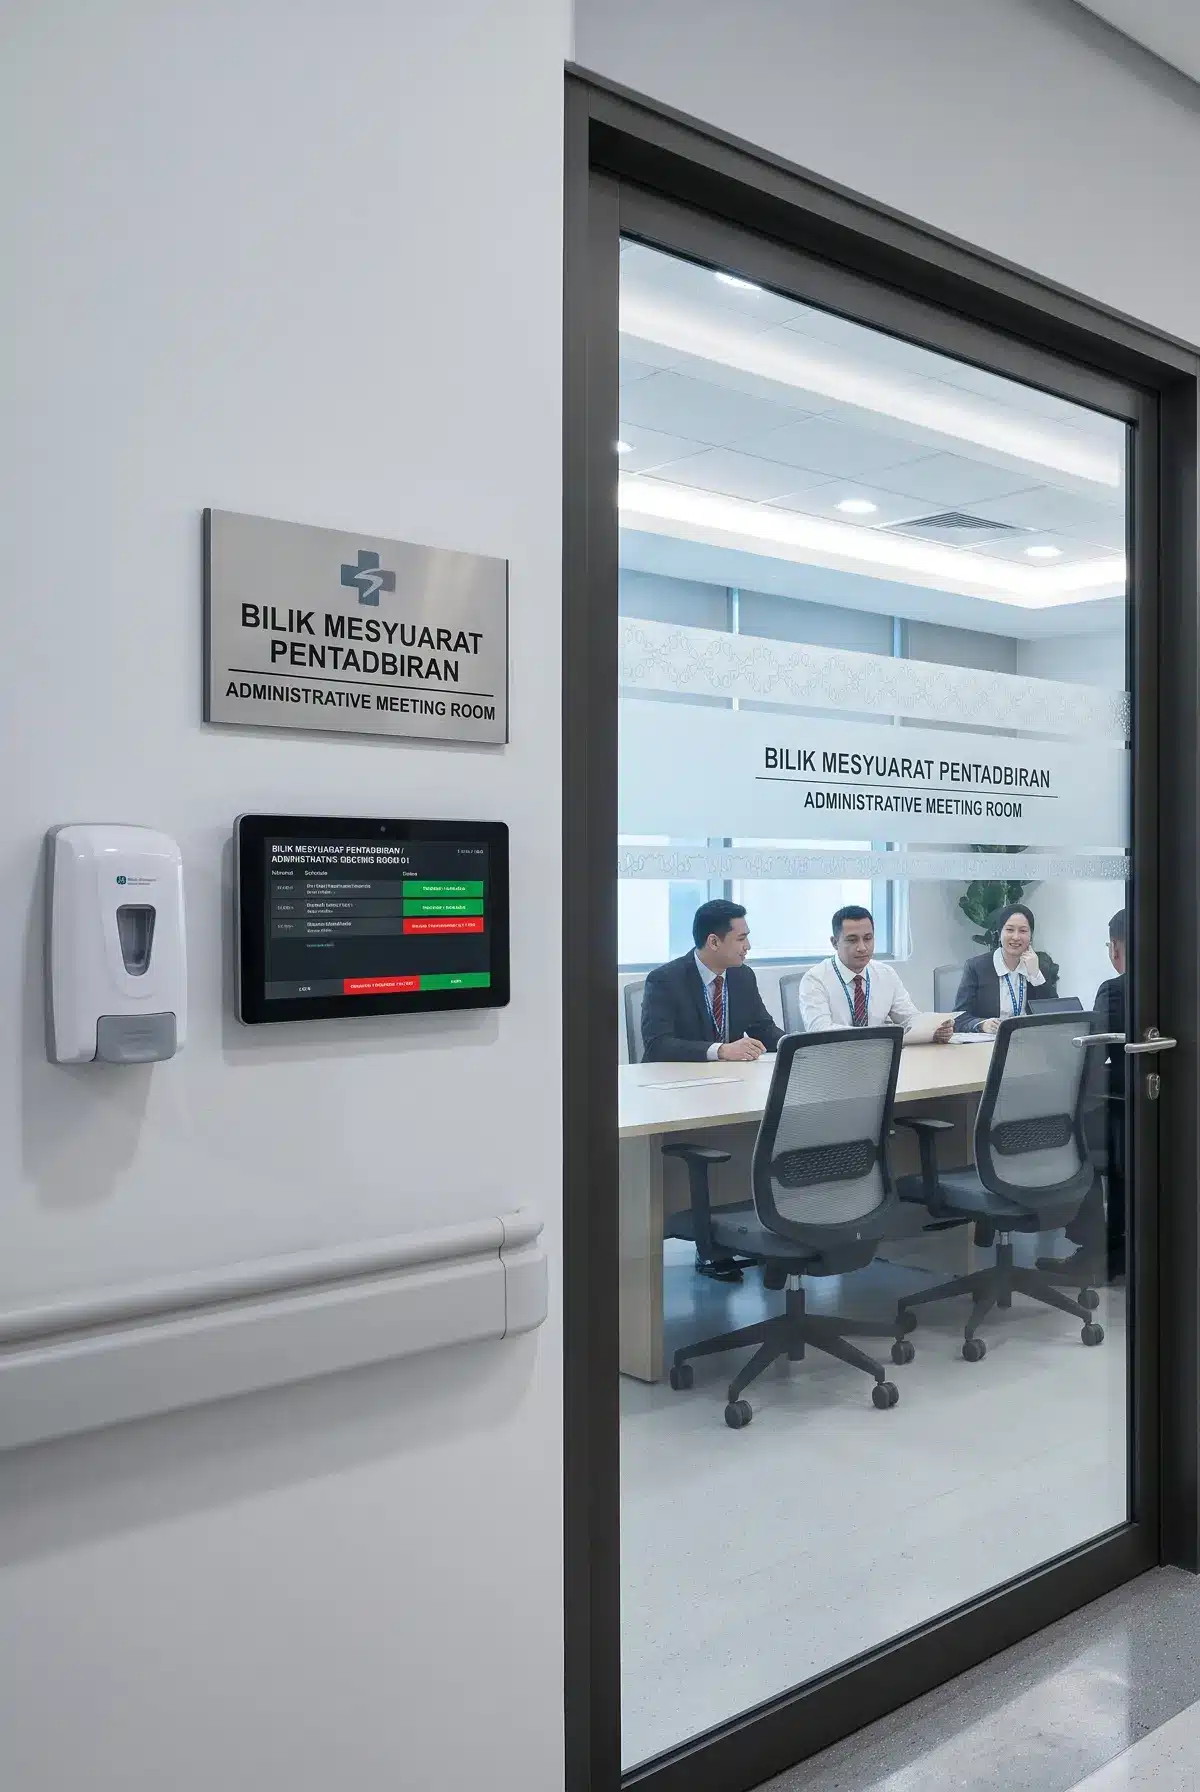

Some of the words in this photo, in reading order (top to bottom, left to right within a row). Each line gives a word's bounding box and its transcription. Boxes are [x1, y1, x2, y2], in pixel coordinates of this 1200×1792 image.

[241, 602, 315, 636] BILIK
[324, 613, 483, 654] MESYUARAT
[270, 640, 459, 682] PENTADBIRAN
[225, 682, 372, 710] ADMINISTRATIVE
[376, 696, 446, 716] MEETING
[450, 703, 496, 720] ROOM
[765, 747, 816, 772] BILIK
[822, 752, 934, 780] MESYUARAT
[940, 761, 1050, 788] PENTADBIRAN
[804, 791, 922, 814] ADMINISTRATIVE
[926, 798, 982, 816] MEETING
[986, 801, 1022, 818] ROOM
[272, 845, 293, 853] BILIK
